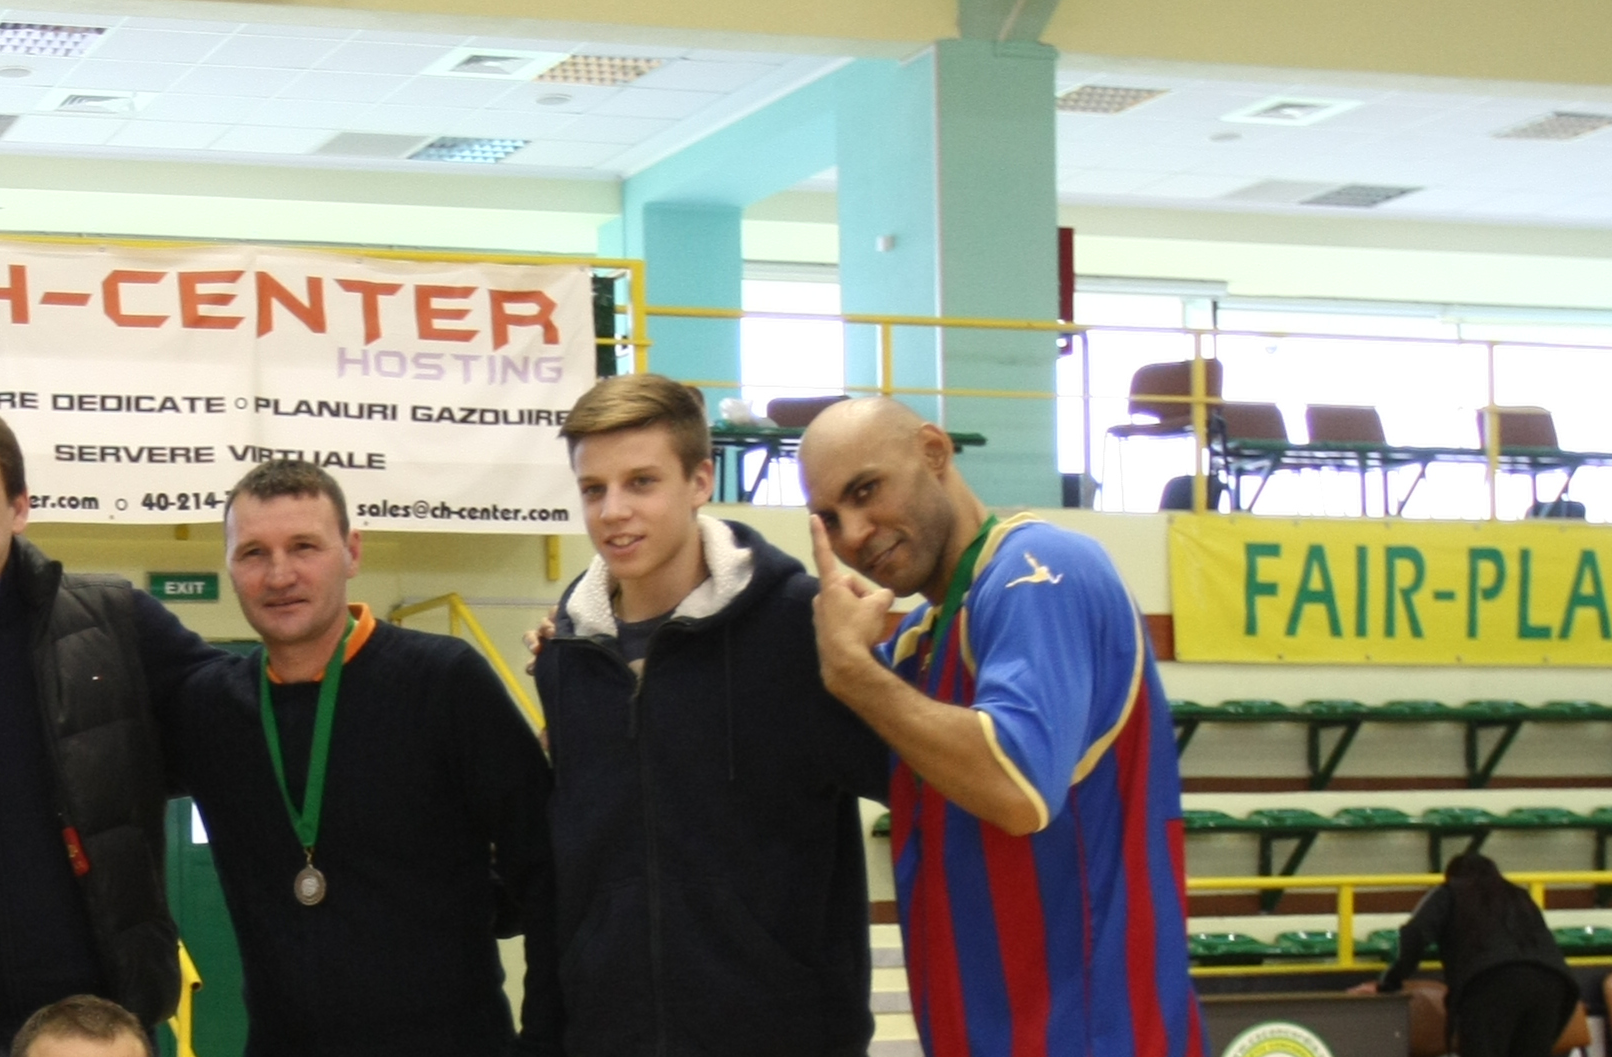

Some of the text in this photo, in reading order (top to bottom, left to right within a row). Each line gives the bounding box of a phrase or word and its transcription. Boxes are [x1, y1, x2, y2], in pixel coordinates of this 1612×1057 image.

[337, 347, 563, 386] HOSTING
[52, 394, 226, 413] DEDICATE
[254, 396, 397, 421] PLANURI
[411, 405, 572, 426] GAZDUIRE
[55, 445, 214, 463] SERVERE
[29, 495, 99, 509] er.com
[357, 500, 569, 522] sales@ch-center.com
[164, 581, 205, 594] EXIT
